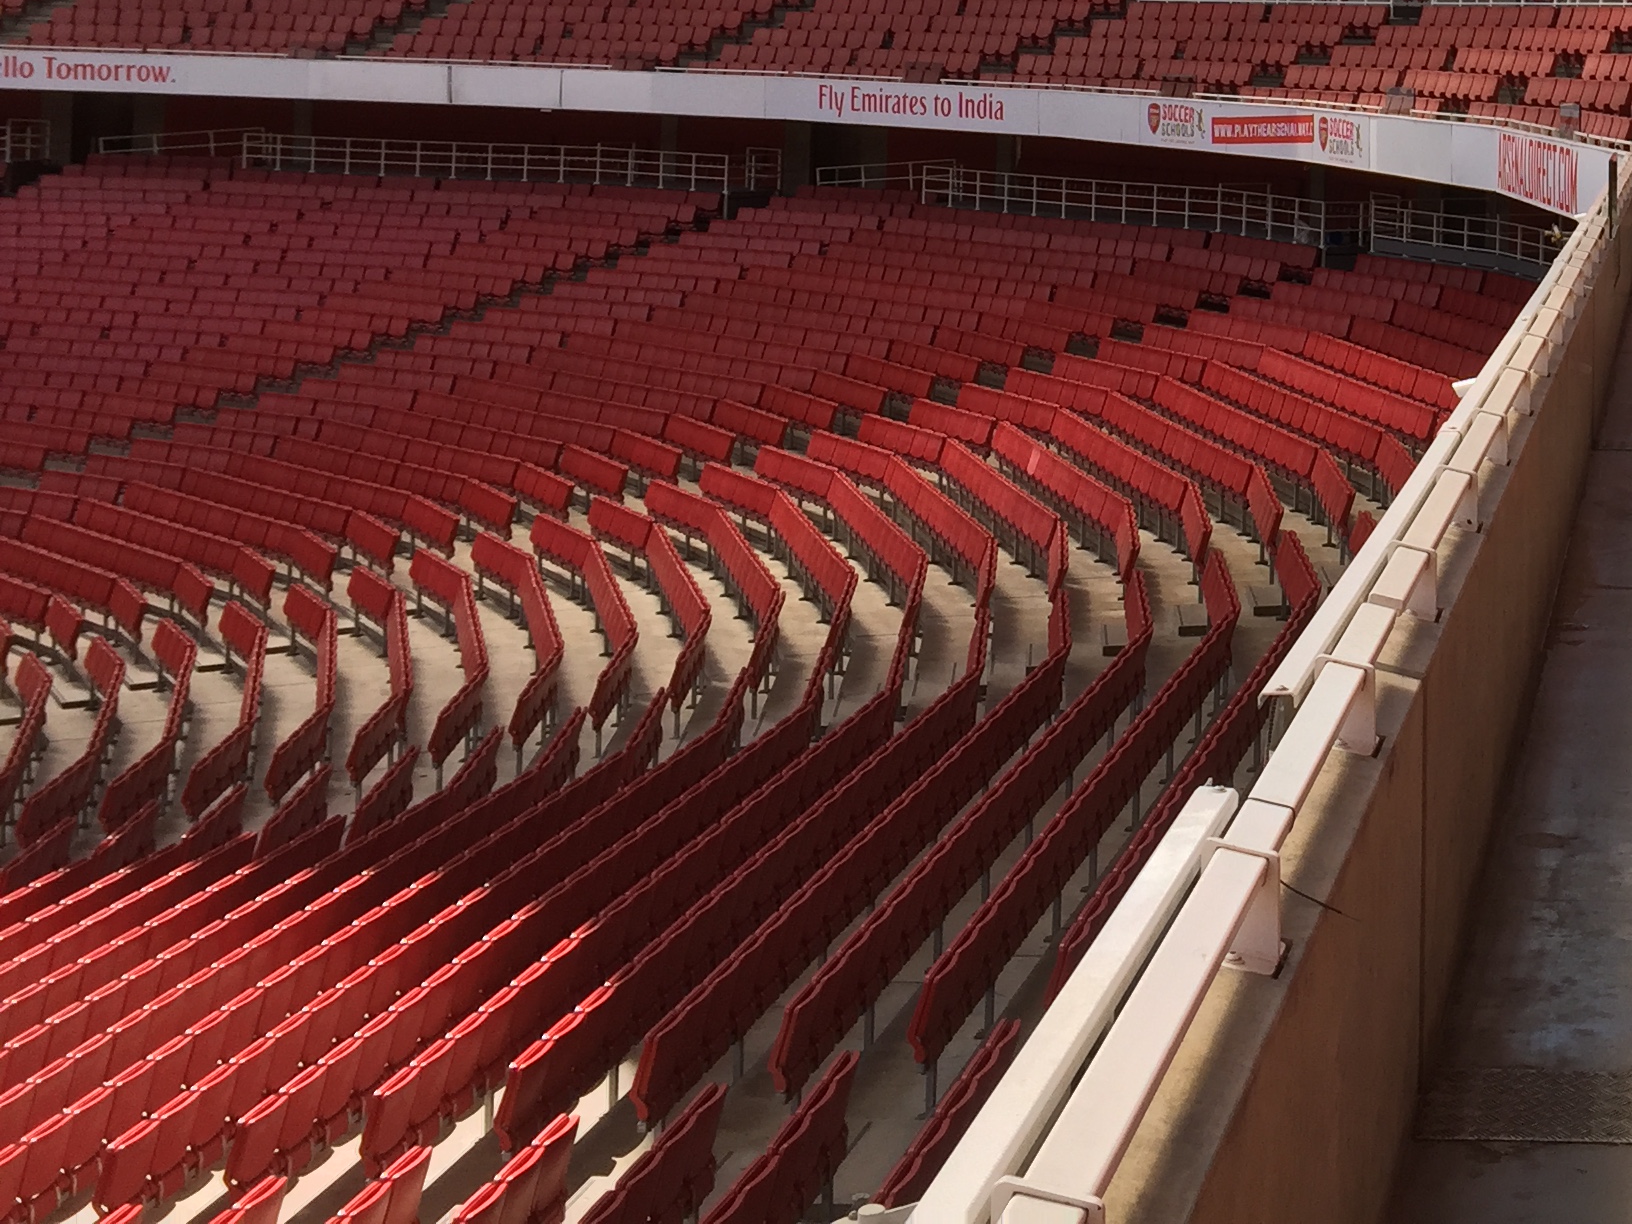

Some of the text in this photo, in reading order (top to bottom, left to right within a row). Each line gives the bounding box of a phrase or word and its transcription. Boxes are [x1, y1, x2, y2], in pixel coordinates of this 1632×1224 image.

[0, 56, 176, 83] llo Tomorrow.
[818, 84, 1005, 121] Fly Emirates to India
[1162, 104, 1194, 124] SOCCER
[1161, 122, 1194, 137] SCHOOLS
[1329, 117, 1354, 141] SOCCER
[1329, 138, 1354, 156] SCHOOLS
[1498, 132, 1578, 214] ARSENALDIRECT.COM
